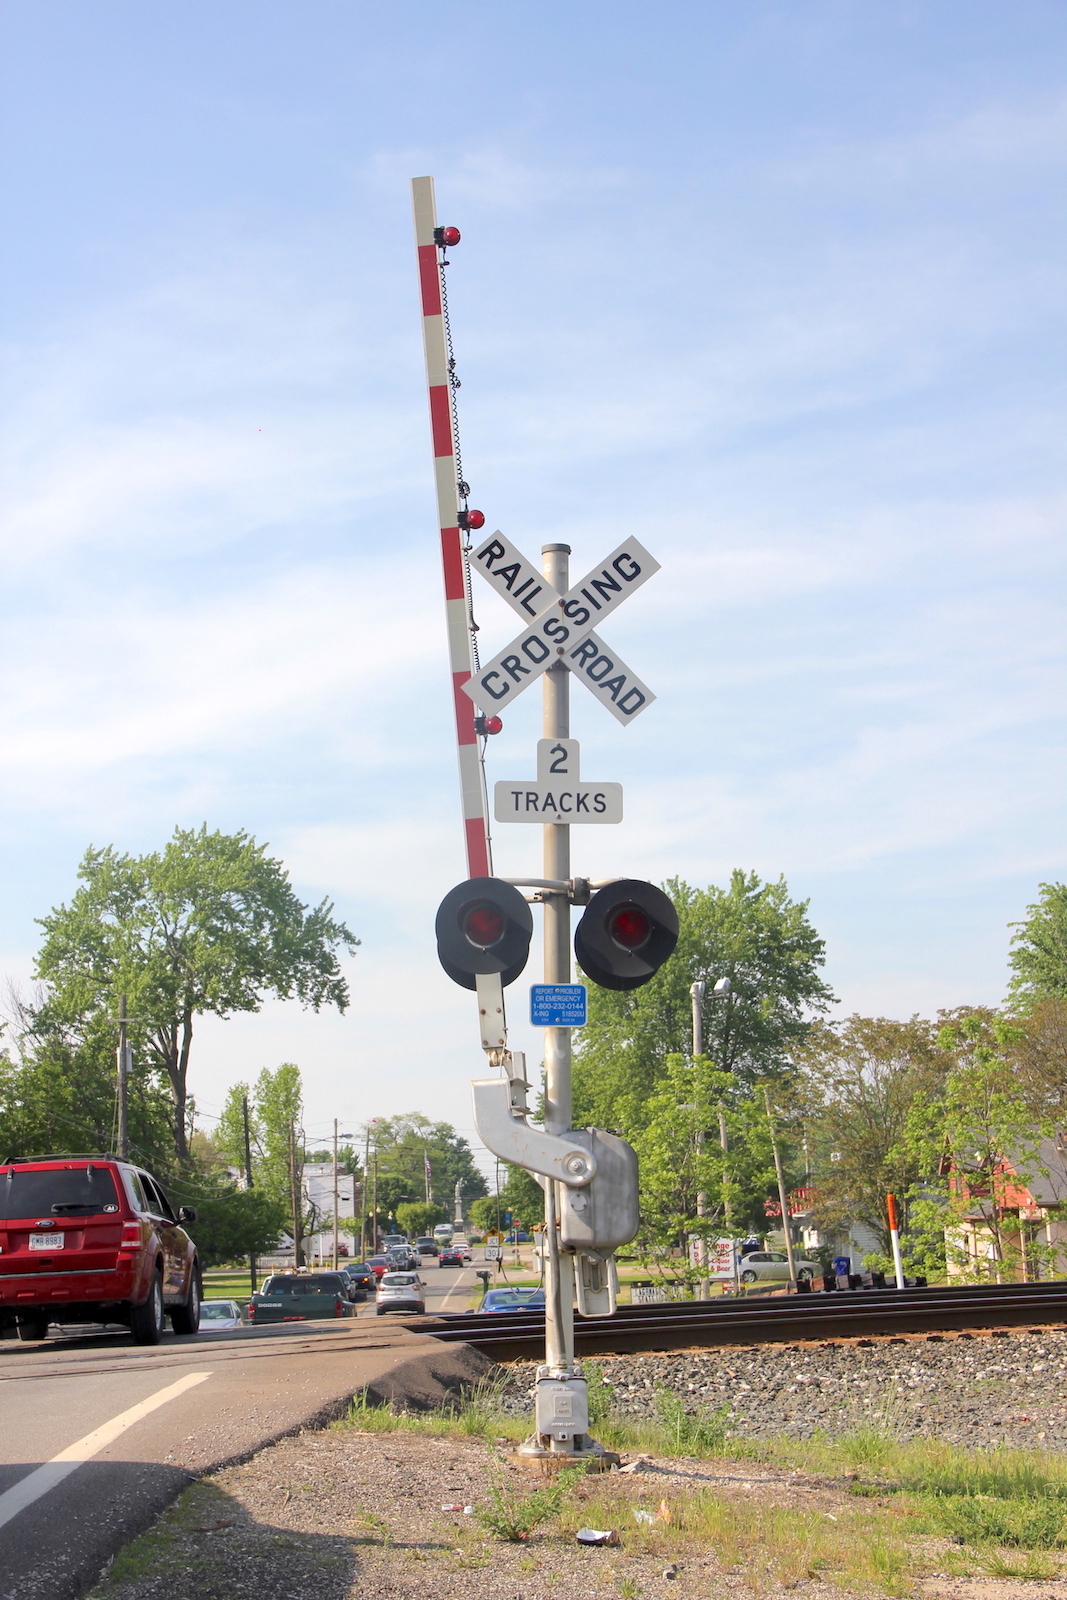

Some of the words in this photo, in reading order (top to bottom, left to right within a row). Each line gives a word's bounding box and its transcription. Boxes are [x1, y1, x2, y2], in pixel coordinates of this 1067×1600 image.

[476, 539, 543, 618] RAIL
[569, 638, 646, 716] ROAD
[481, 552, 642, 700] CROSSING
[549, 746, 568, 774] 2
[511, 791, 607, 814] TRACKS
[45, 1236, 61, 1246] 8983
